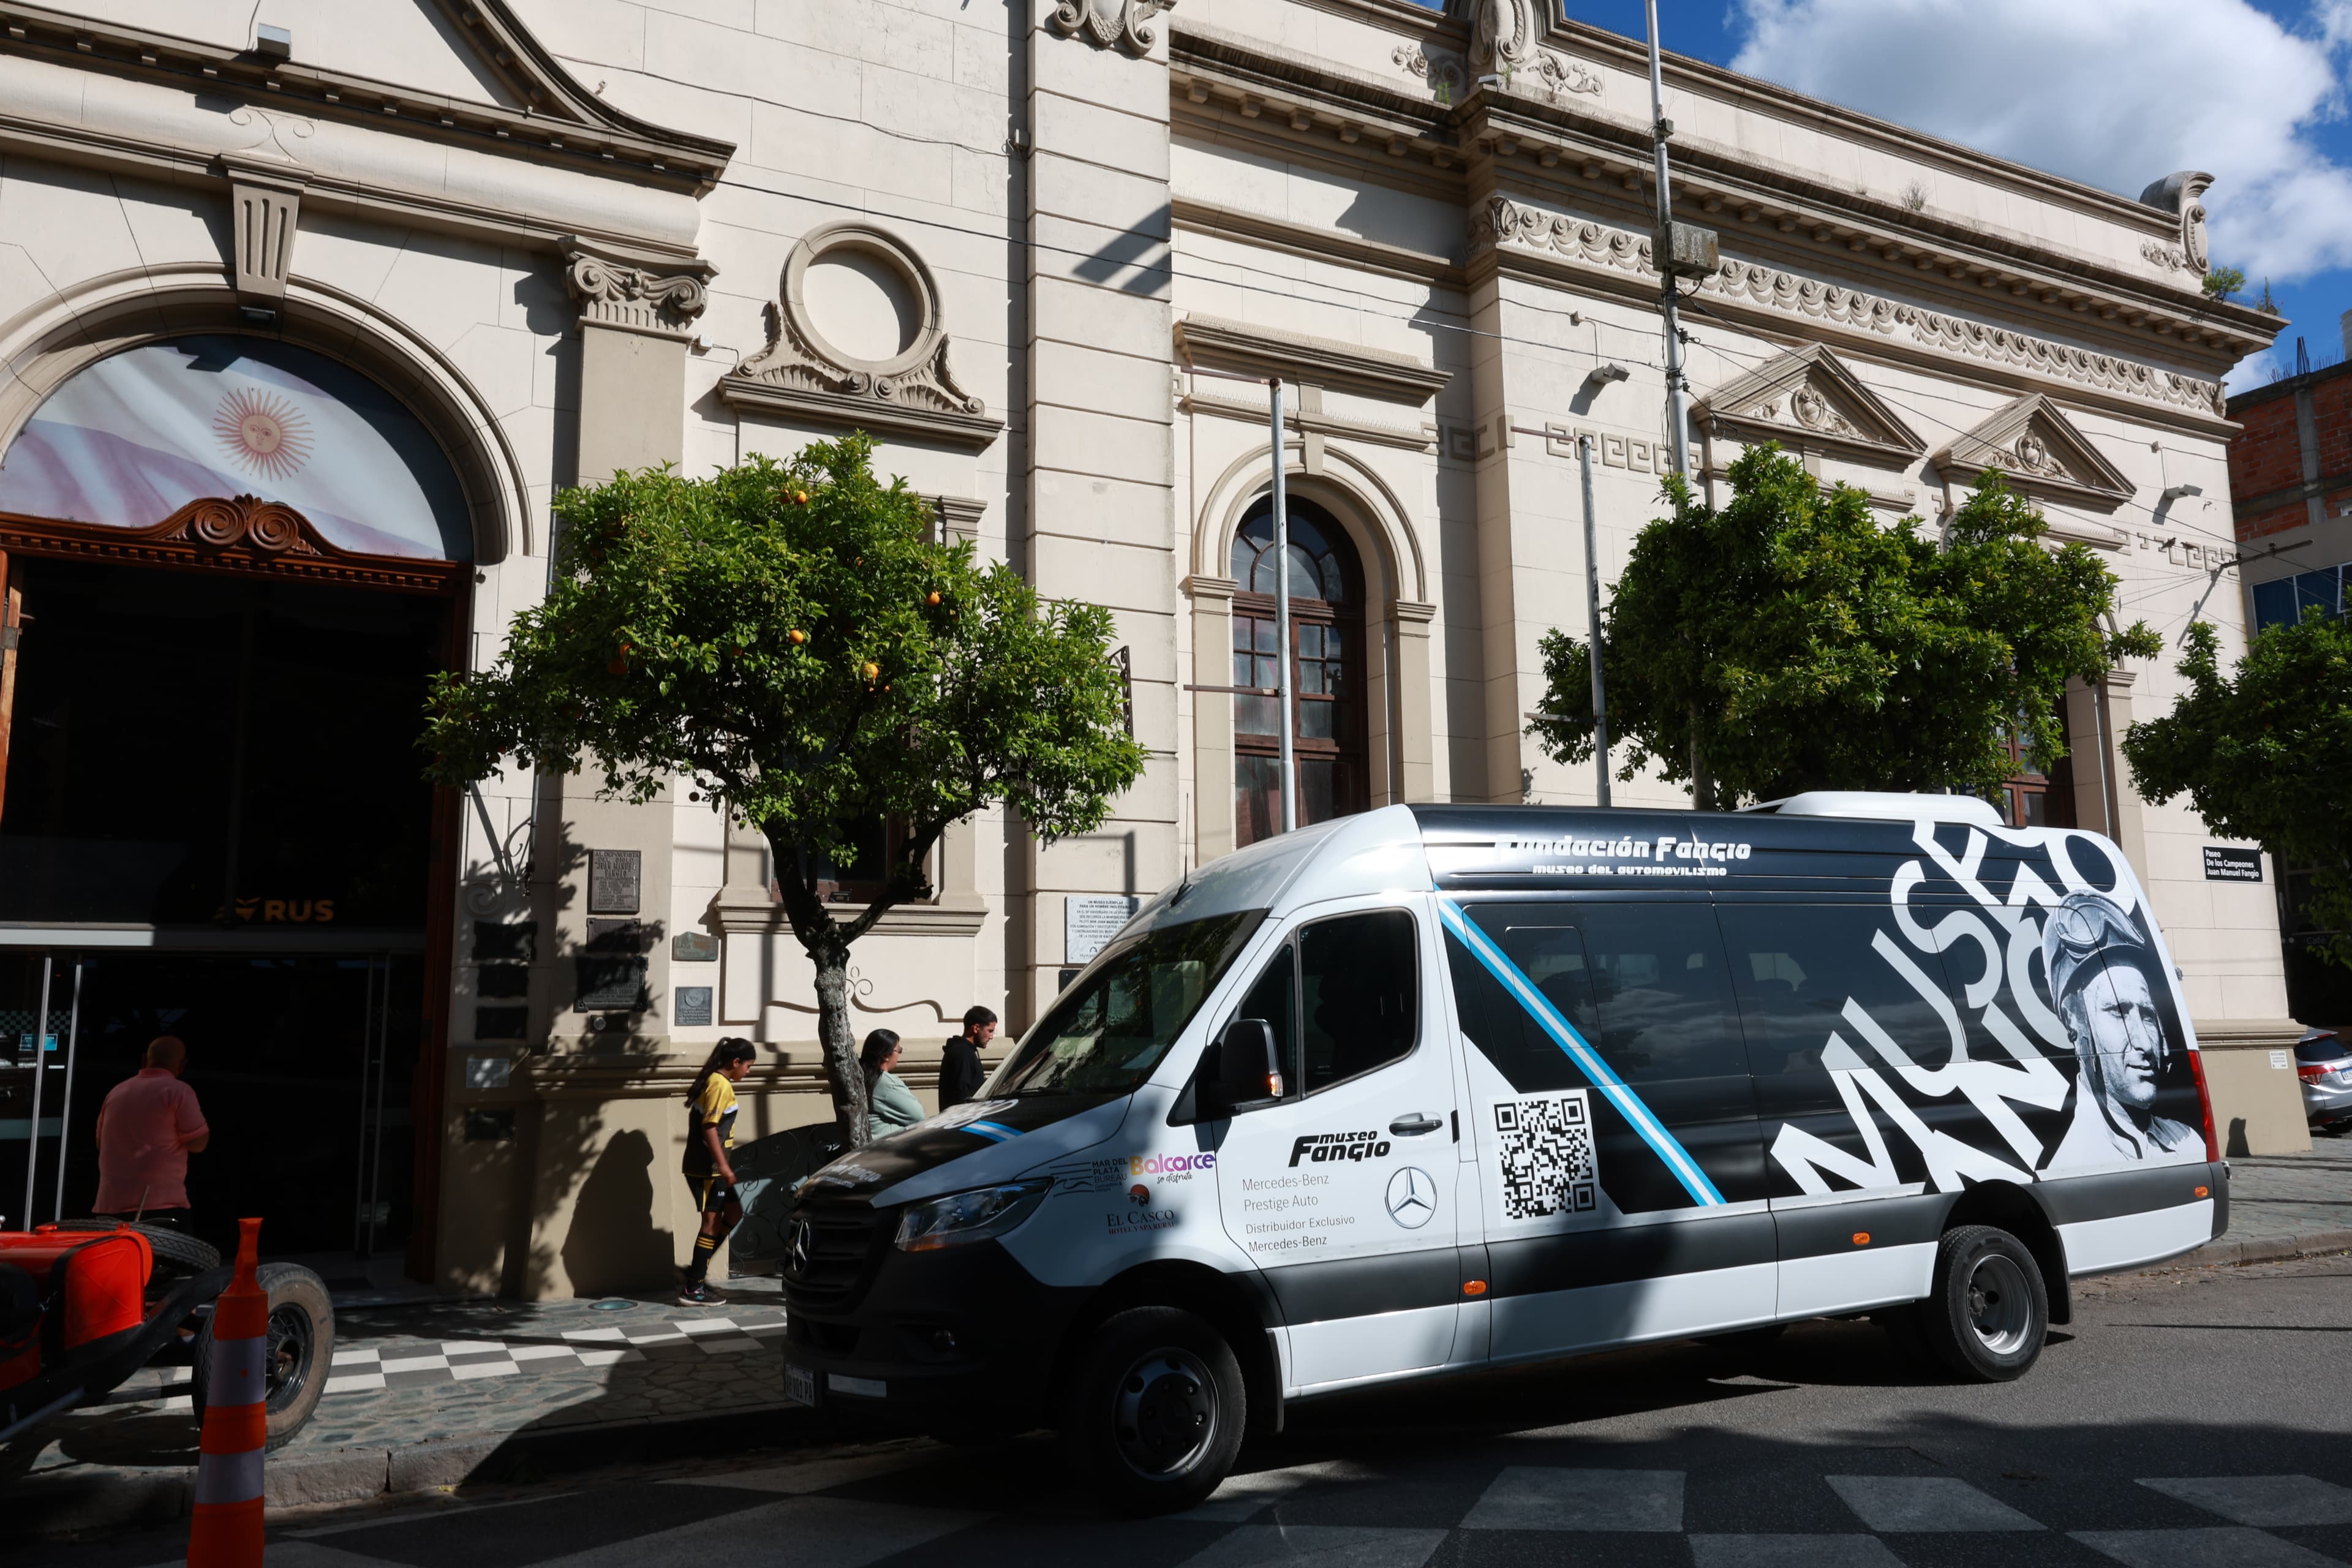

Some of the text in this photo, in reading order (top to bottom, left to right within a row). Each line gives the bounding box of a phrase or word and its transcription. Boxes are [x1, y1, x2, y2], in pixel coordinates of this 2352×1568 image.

[1496, 834, 1751, 862] Fundación Fangio
[1532, 864, 1727, 876] museo del automovilismo
[2223, 860, 2254, 869] Campeones
[2241, 870, 2259, 878] Fangio
[265, 900, 334, 922] RUS
[1319, 1131, 1378, 1144] museo
[1288, 1135, 1391, 1167] Fangio
[1092, 1159, 1110, 1168] MAR
[1093, 1166, 1120, 1175] PLATA
[1129, 1153, 1215, 1175] Balcarce
[1094, 1174, 1127, 1183] BUREAU
[1242, 1174, 1330, 1191] Mercedes-Benz
[1244, 1195, 1318, 1212] Prestige Auto
[1109, 1226, 1132, 1235] HOTEL
[1246, 1215, 1355, 1234] Distribuidor Exclusivo
[1249, 1236, 1327, 1252] Mercedes-Benz
